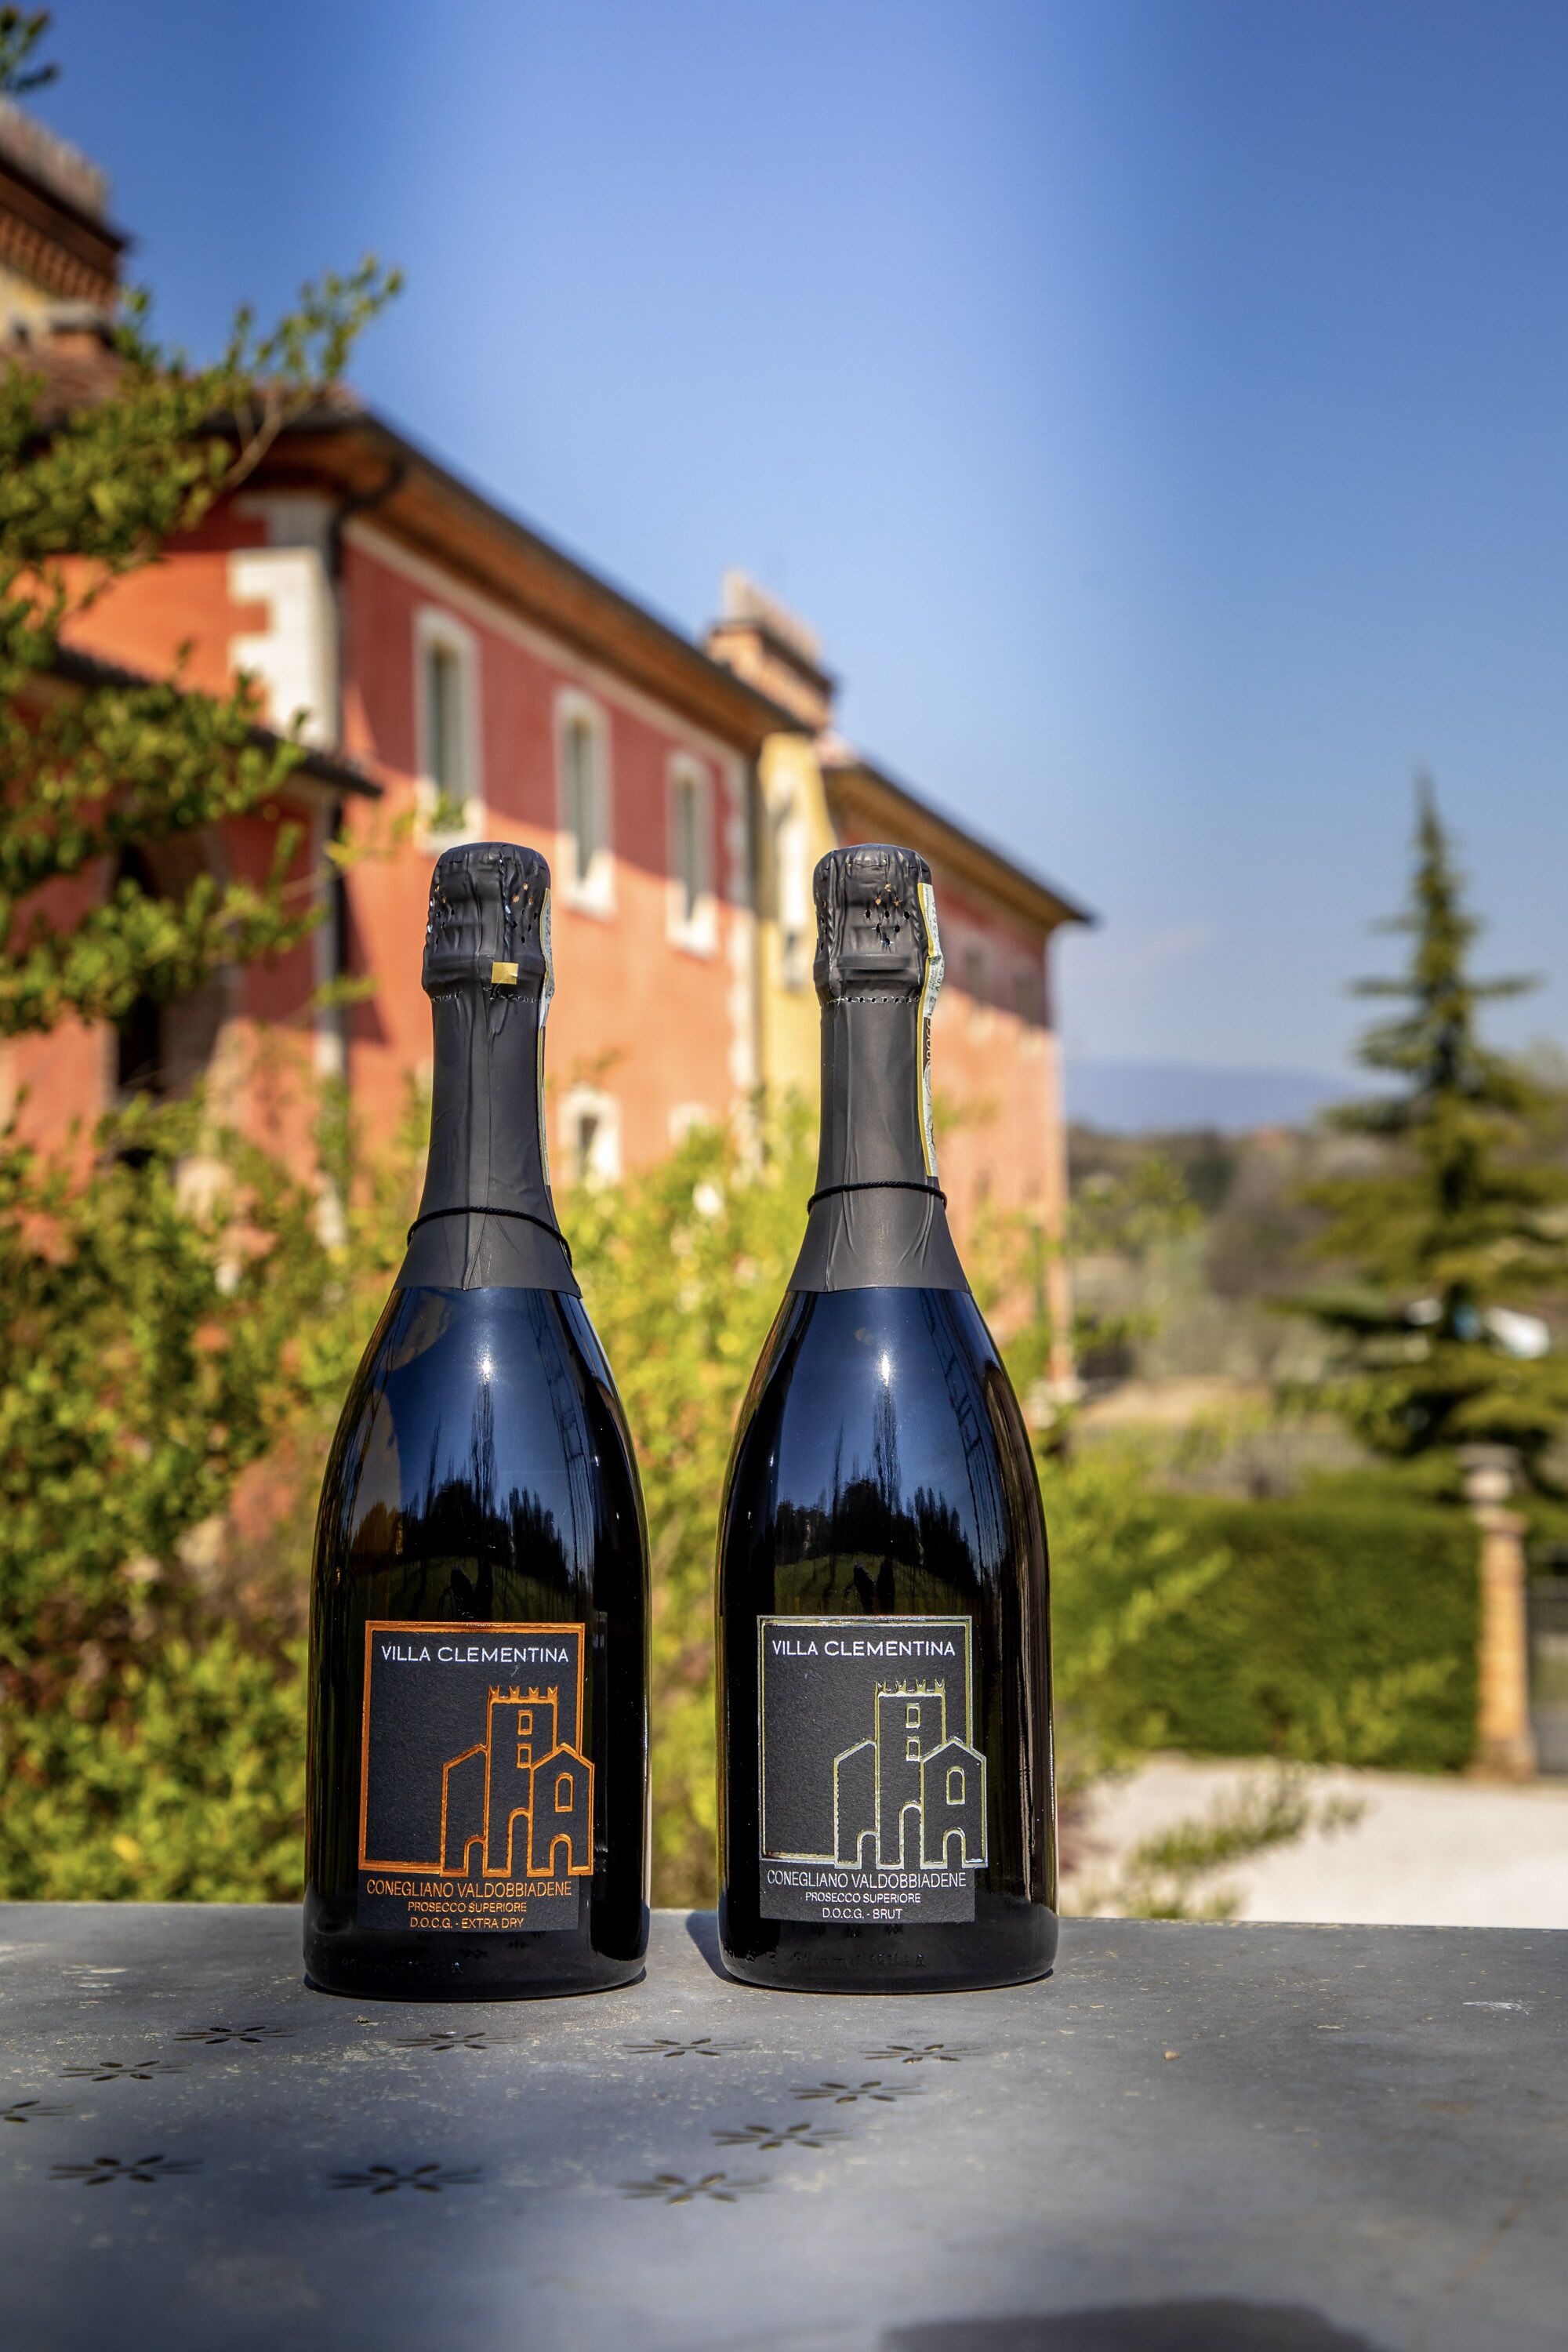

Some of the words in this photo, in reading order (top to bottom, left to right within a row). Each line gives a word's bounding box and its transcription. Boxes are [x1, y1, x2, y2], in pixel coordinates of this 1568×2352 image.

[382, 1646, 430, 1661] VILLA
[437, 1647, 568, 1663] CLEMENTINA
[773, 1640, 818, 1656] VILLA
[824, 1640, 956, 1657] CLEMENTINA
[767, 1870, 848, 1888] CONEGLIANO
[851, 1872, 966, 1889] VALDOBBIADENE
[366, 1879, 453, 1897] CONEGLIANO
[457, 1881, 572, 1897] VALDOBBIADENE
[805, 1893, 861, 1904] PROSECCO
[863, 1893, 921, 1904] SUPERIORE
[408, 1902, 466, 1913] PROSECCO
[468, 1902, 527, 1913] SUPERIORE
[822, 1908, 865, 1919] D.O.C.G.
[873, 1908, 902, 1919] BRUT
[410, 1917, 452, 1929] D.O.C.G.
[461, 1918, 499, 1929] EXTRA
[501, 1917, 524, 1928] DRY
